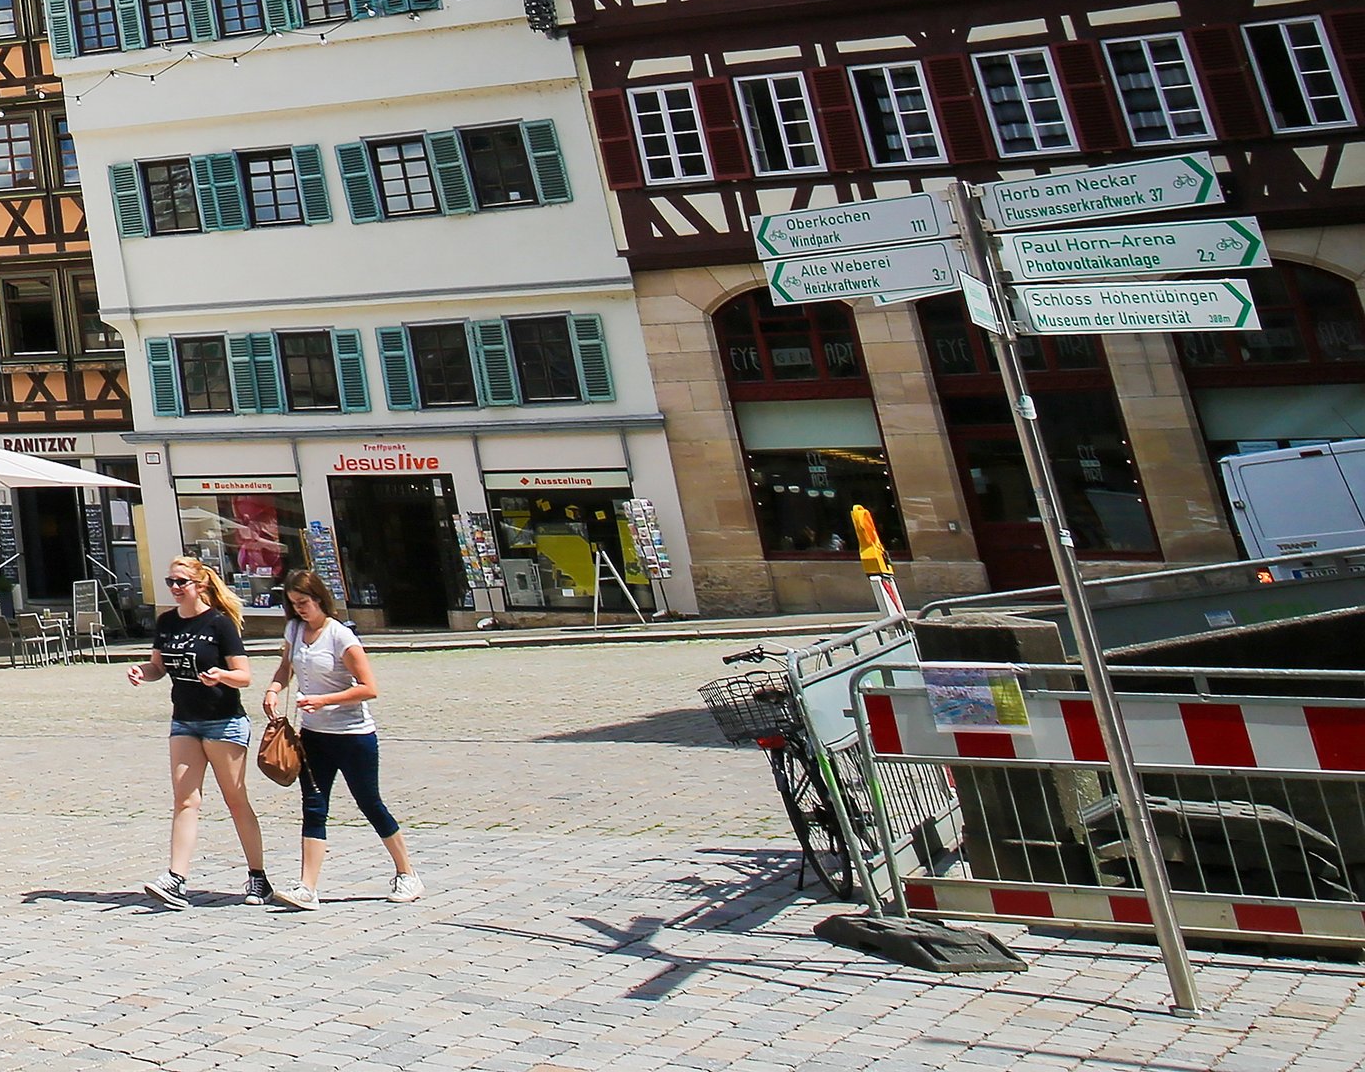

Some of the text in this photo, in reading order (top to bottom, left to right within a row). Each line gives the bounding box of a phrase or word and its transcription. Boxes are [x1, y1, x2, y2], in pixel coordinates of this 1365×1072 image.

[999, 173, 1138, 202] Horb am Neckar
[1005, 187, 1164, 221] Flusswasserkraftwerk 37
[786, 211, 927, 233] Oberkochen 111
[788, 231, 842, 248] Windpark
[1021, 232, 1176, 254] Paul Horn-Arena
[800, 261, 828, 278] Alte
[830, 255, 892, 273] Weberei
[1025, 253, 1161, 273] Photovoltaikanlage
[803, 275, 881, 295] Heizkraftwerk
[1031, 293, 1093, 307] Schloss
[1036, 312, 1092, 327] Museum
[1094, 311, 1115, 326] der
[1117, 310, 1192, 326] Universität
[3, 437, 77, 453] RANITZKY
[362, 443, 407, 453] Treffpunkt
[214, 481, 273, 491] Buchhandlung
[534, 477, 592, 486] Ausstellung
